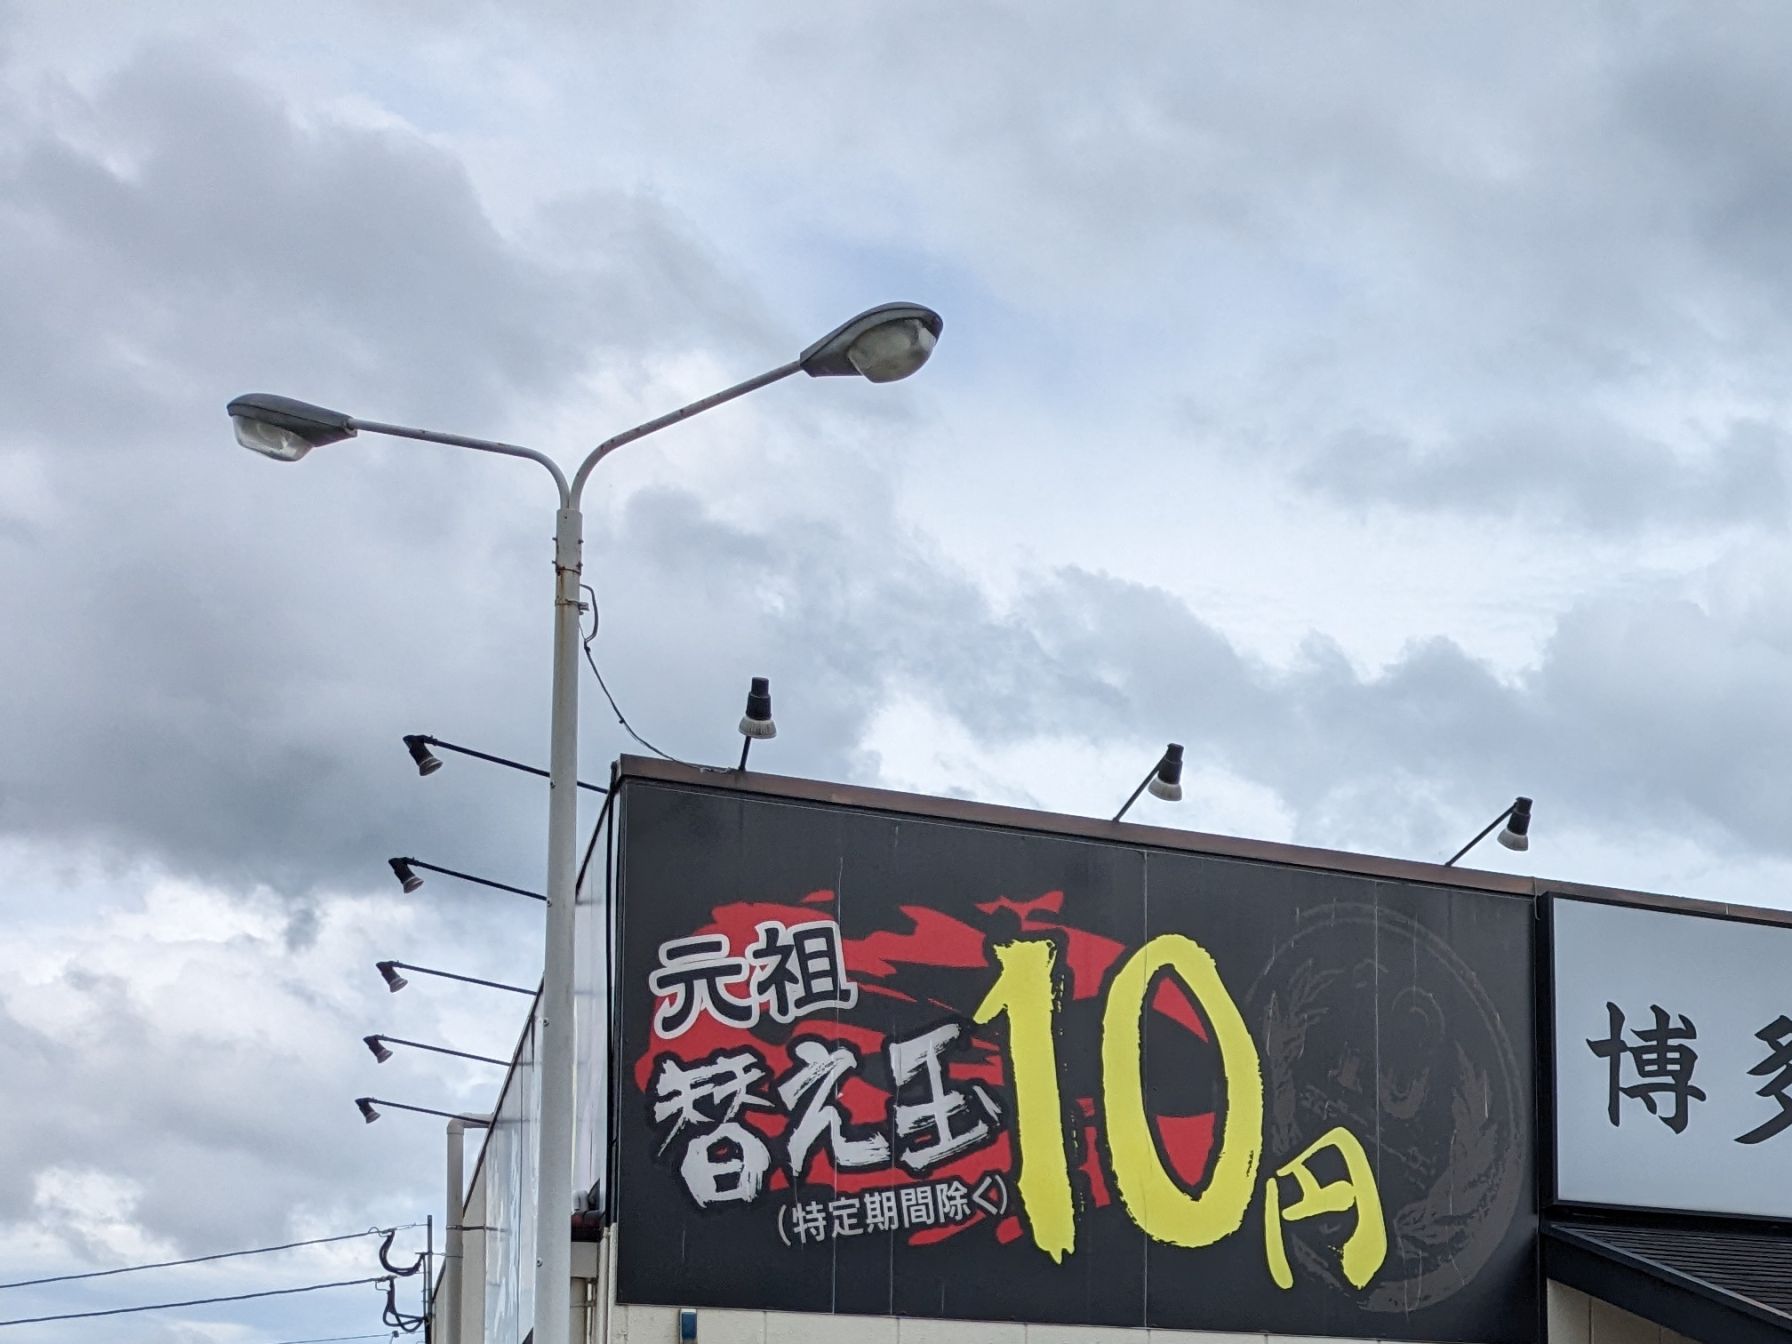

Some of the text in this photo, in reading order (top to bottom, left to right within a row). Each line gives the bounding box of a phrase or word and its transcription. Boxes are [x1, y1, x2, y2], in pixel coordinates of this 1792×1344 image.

[648, 920, 858, 1040] 元祖
[653, 1022, 1003, 1207] 替え玉
[777, 1175, 1008, 1247] (特定期間除く)
